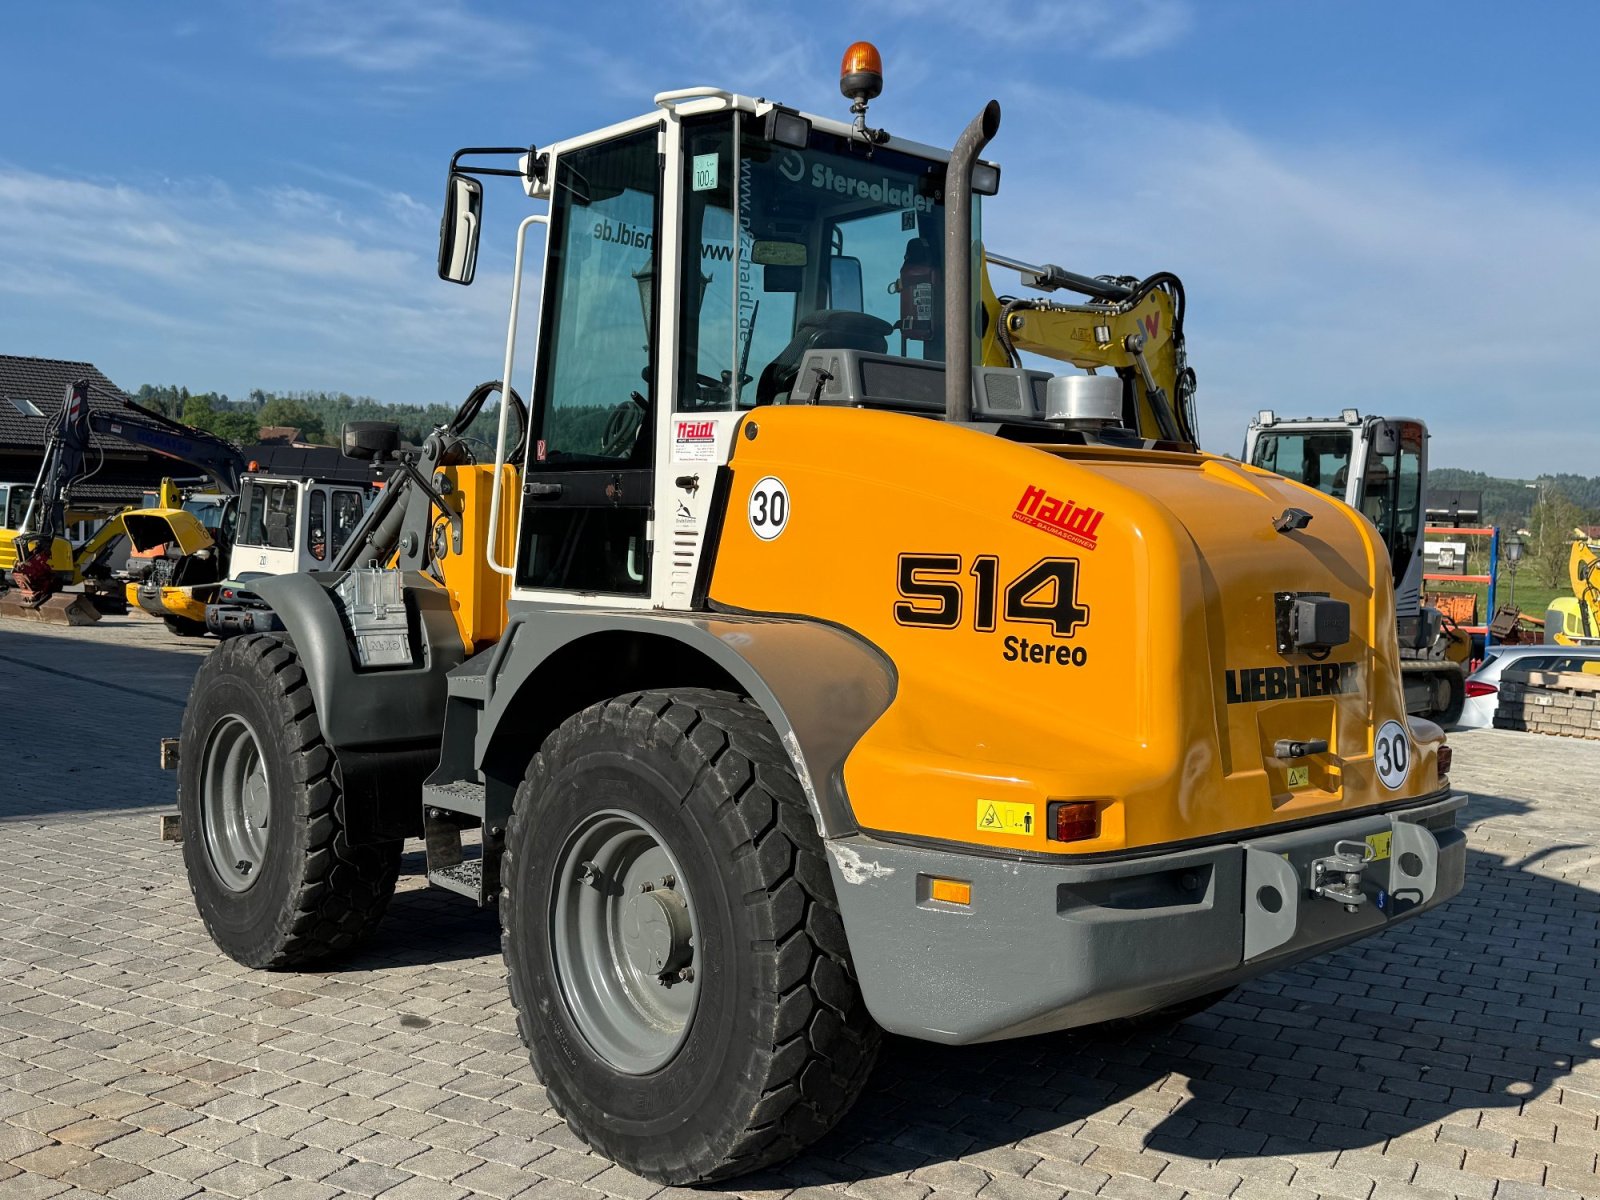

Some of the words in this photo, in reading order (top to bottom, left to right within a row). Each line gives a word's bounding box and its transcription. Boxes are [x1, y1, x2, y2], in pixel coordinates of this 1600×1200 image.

[697, 169, 710, 187] 100
[811, 163, 935, 213] Stereolader
[739, 157, 755, 342] www.nfz-haidl.de
[677, 421, 714, 438] Haidl
[753, 490, 785, 527] 30
[1016, 484, 1105, 542] Haidl
[1013, 512, 1033, 524] NUTZ
[1036, 521, 1095, 550] BAUMASCHINEN
[259, 555, 267, 566] 20
[893, 552, 1090, 639] 514
[1002, 635, 1088, 667] Stereo
[1225, 661, 1360, 704] LIEBHERR
[1377, 733, 1407, 777] 30
